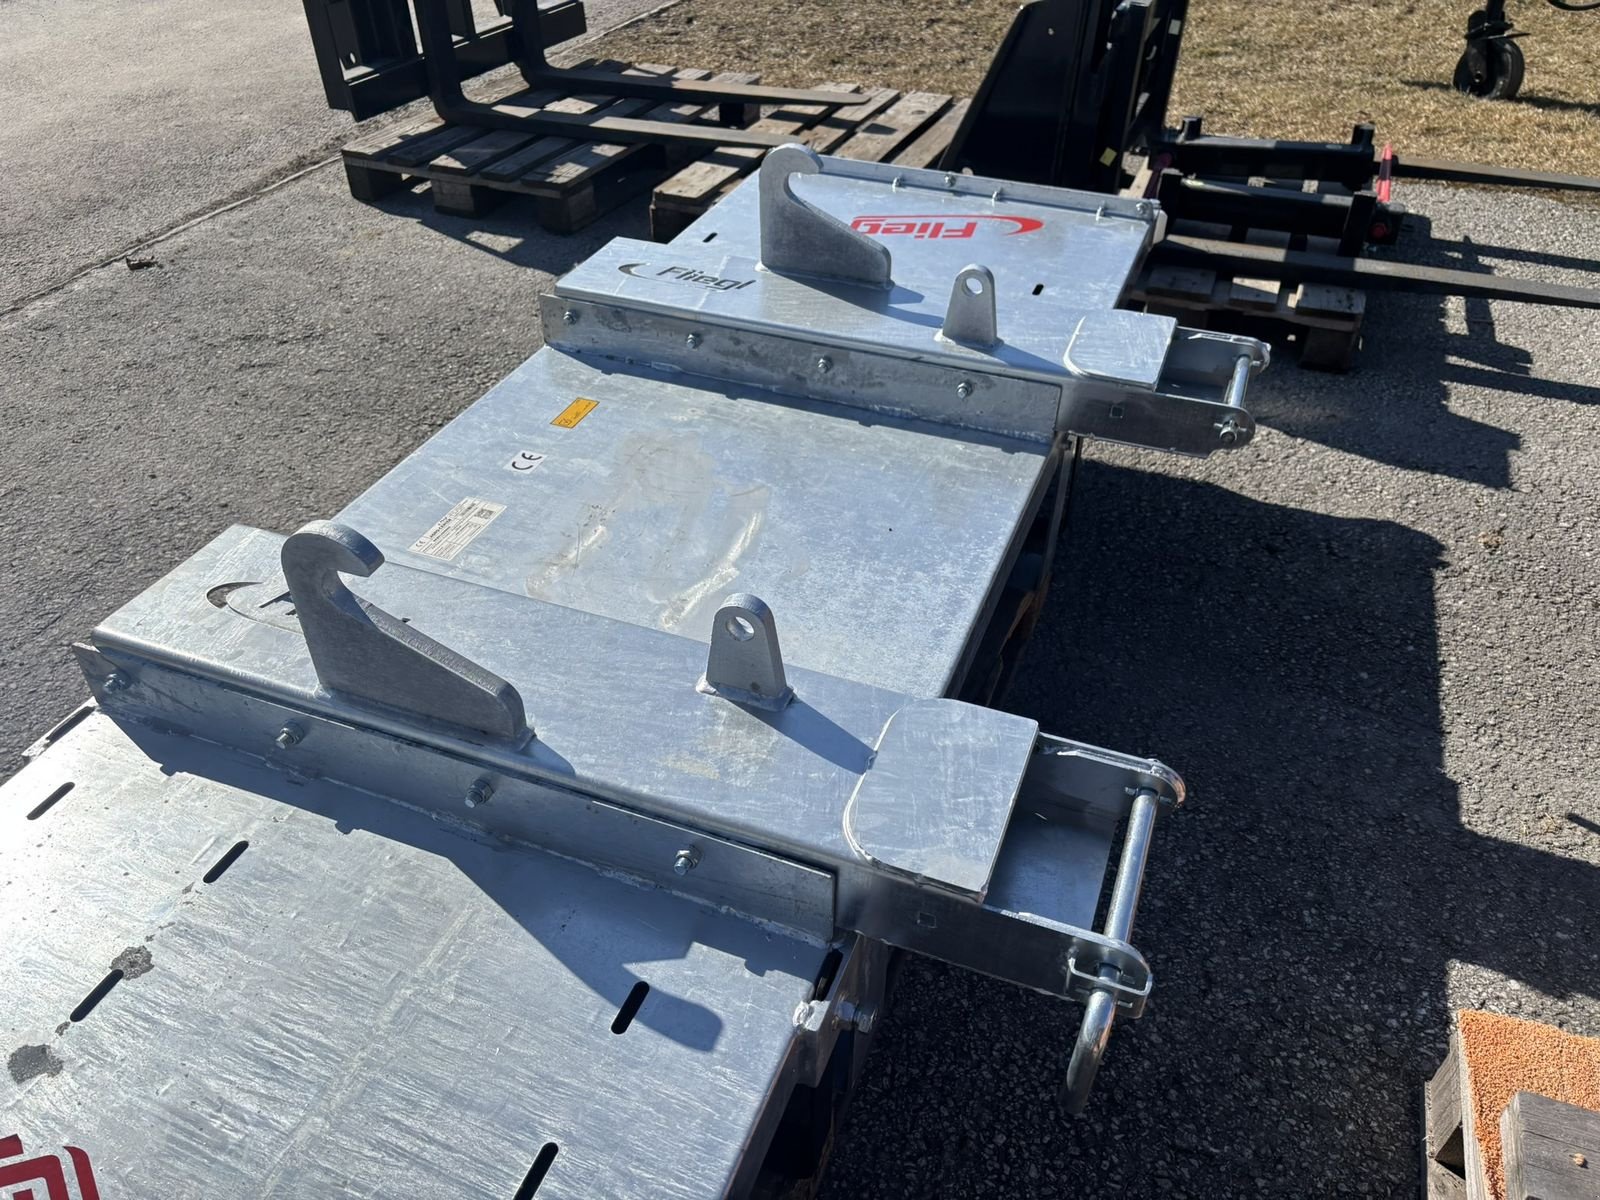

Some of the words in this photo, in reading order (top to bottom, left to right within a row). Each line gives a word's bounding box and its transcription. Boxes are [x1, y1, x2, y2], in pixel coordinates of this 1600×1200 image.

[850, 219, 978, 239] Flieg
[656, 265, 756, 291] Fliegl
[511, 452, 543, 471] CE
